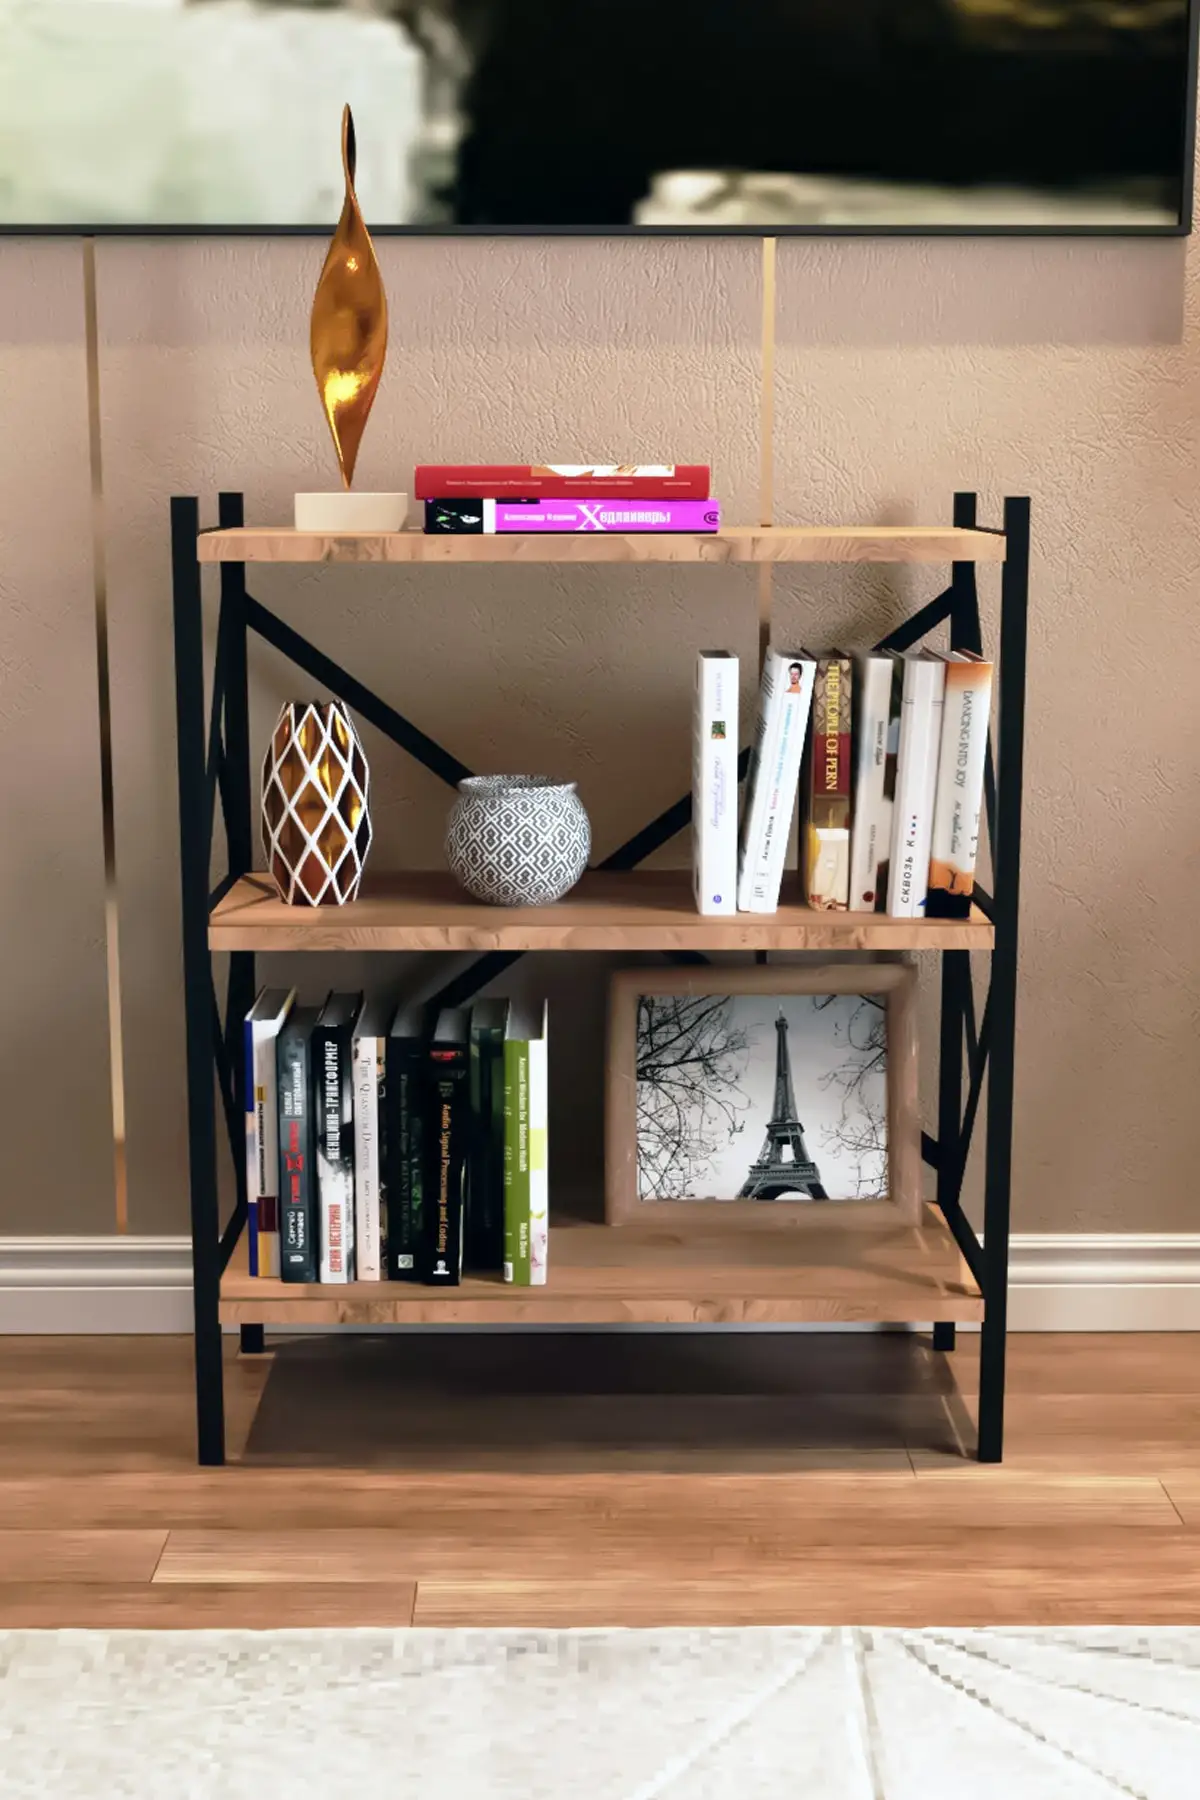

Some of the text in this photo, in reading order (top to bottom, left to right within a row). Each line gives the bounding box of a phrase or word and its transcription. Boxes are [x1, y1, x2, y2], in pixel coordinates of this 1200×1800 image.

[825, 665, 840, 791] THE PEOPLE OF PERN
[959, 690, 973, 742] DANCING
[957, 743, 970, 769] INTO
[954, 769, 967, 788] JOY
[901, 856, 914, 903] СКВОЗЬ
[324, 1040, 341, 1160] ЖЕНЩИНА-ТРАНСФОРМЕР
[441, 1104, 452, 1129] Audio
[438, 1130, 452, 1158] Signal
[437, 1159, 450, 1204] Processing
[439, 1206, 449, 1222] and
[436, 1223, 449, 1253] Coding
[519, 1222, 528, 1240] Mark
